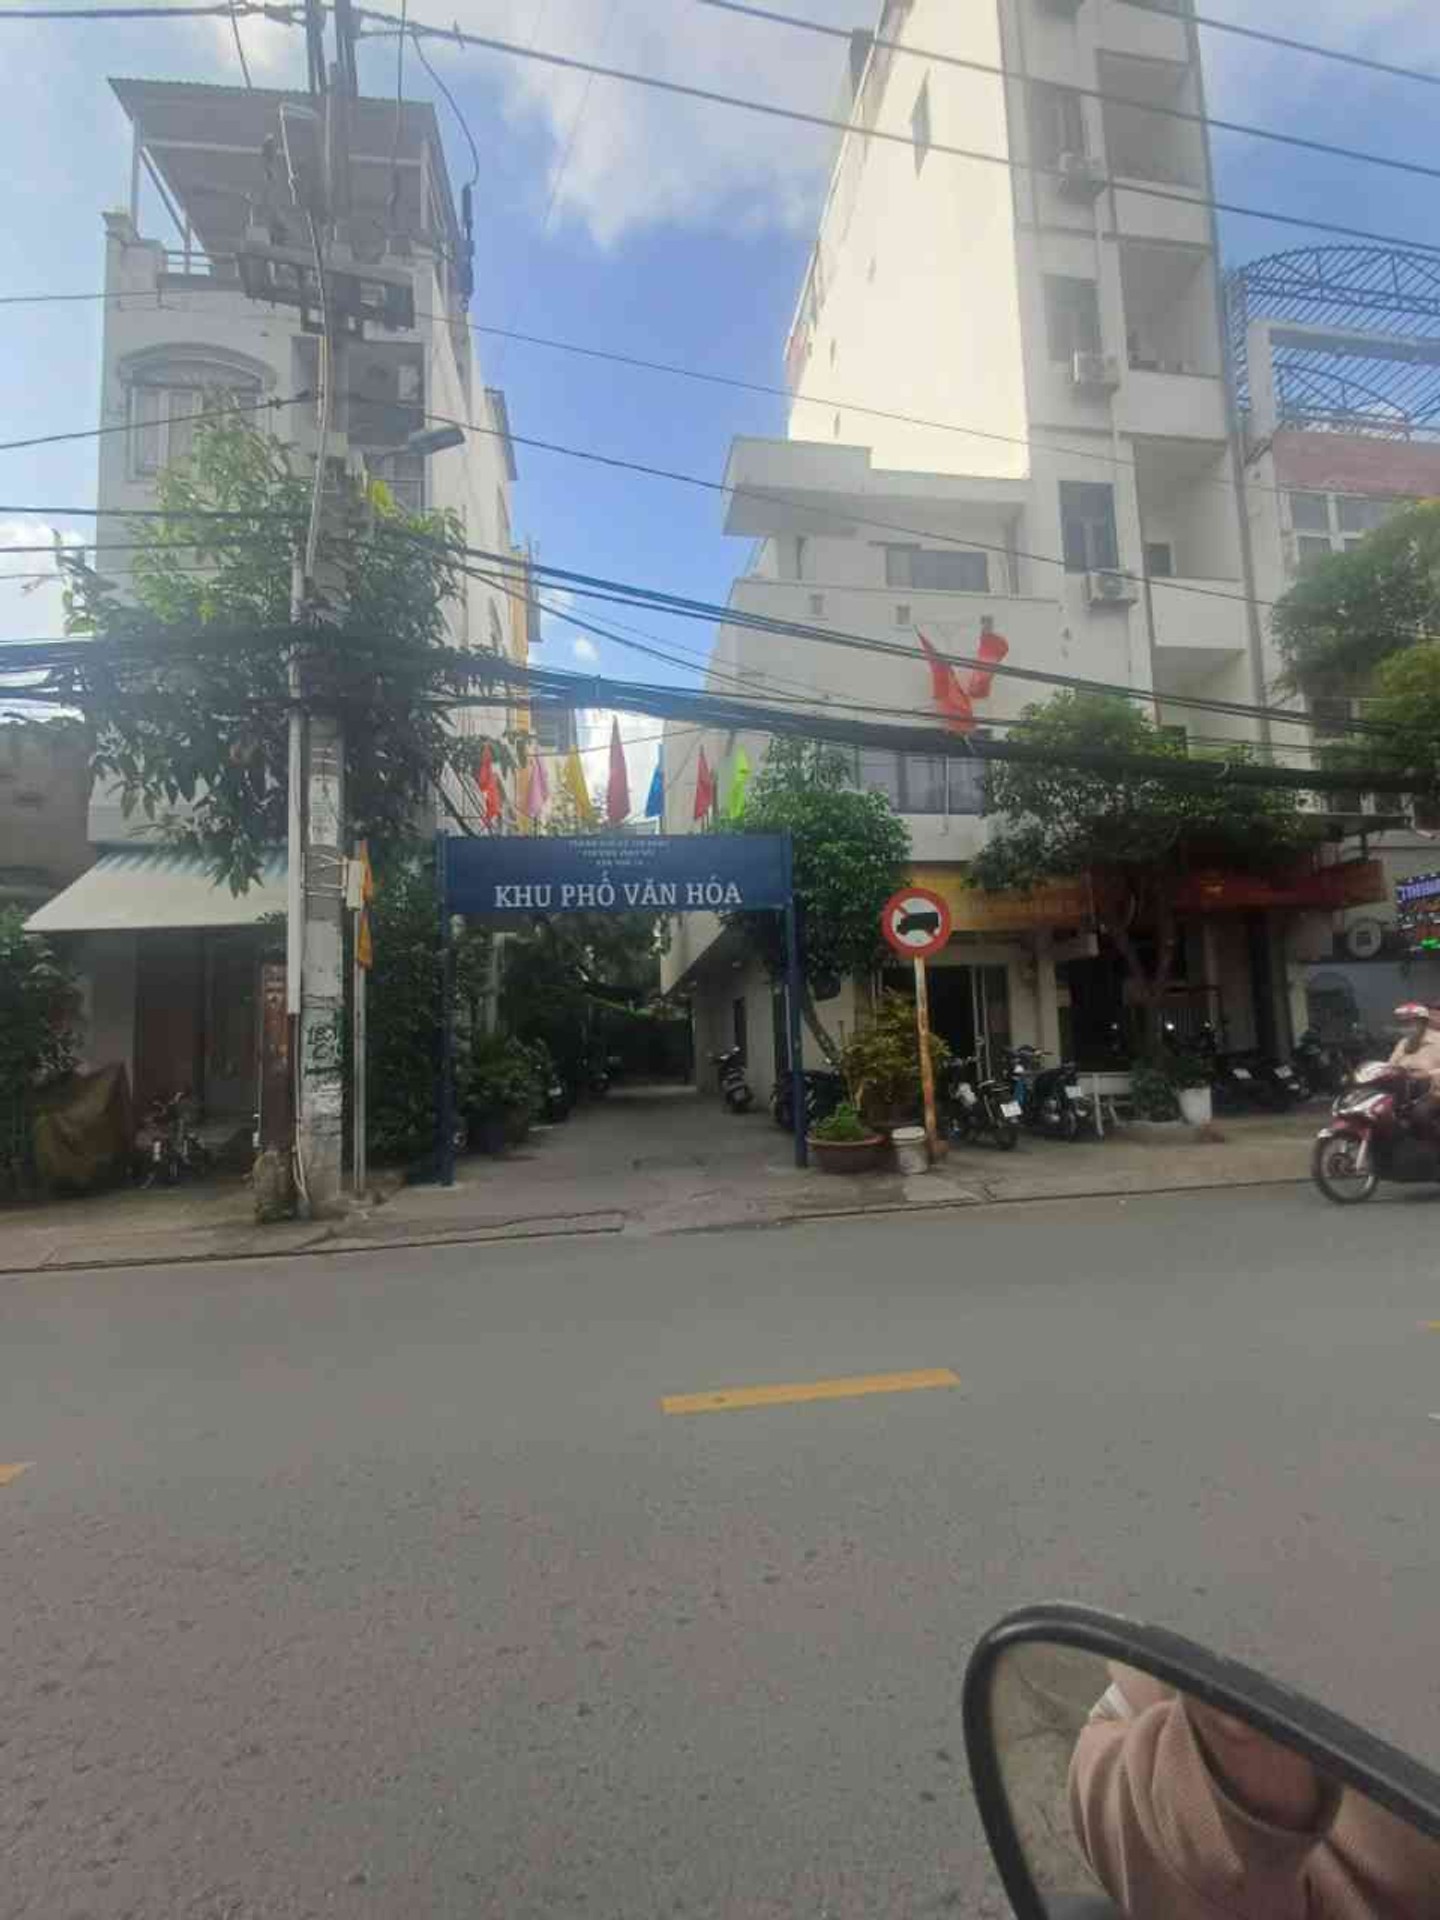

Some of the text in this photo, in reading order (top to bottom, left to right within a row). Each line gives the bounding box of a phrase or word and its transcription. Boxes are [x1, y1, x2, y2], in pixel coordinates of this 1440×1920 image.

[494, 870, 743, 907] KHU PHỐ VĂN HÓA
